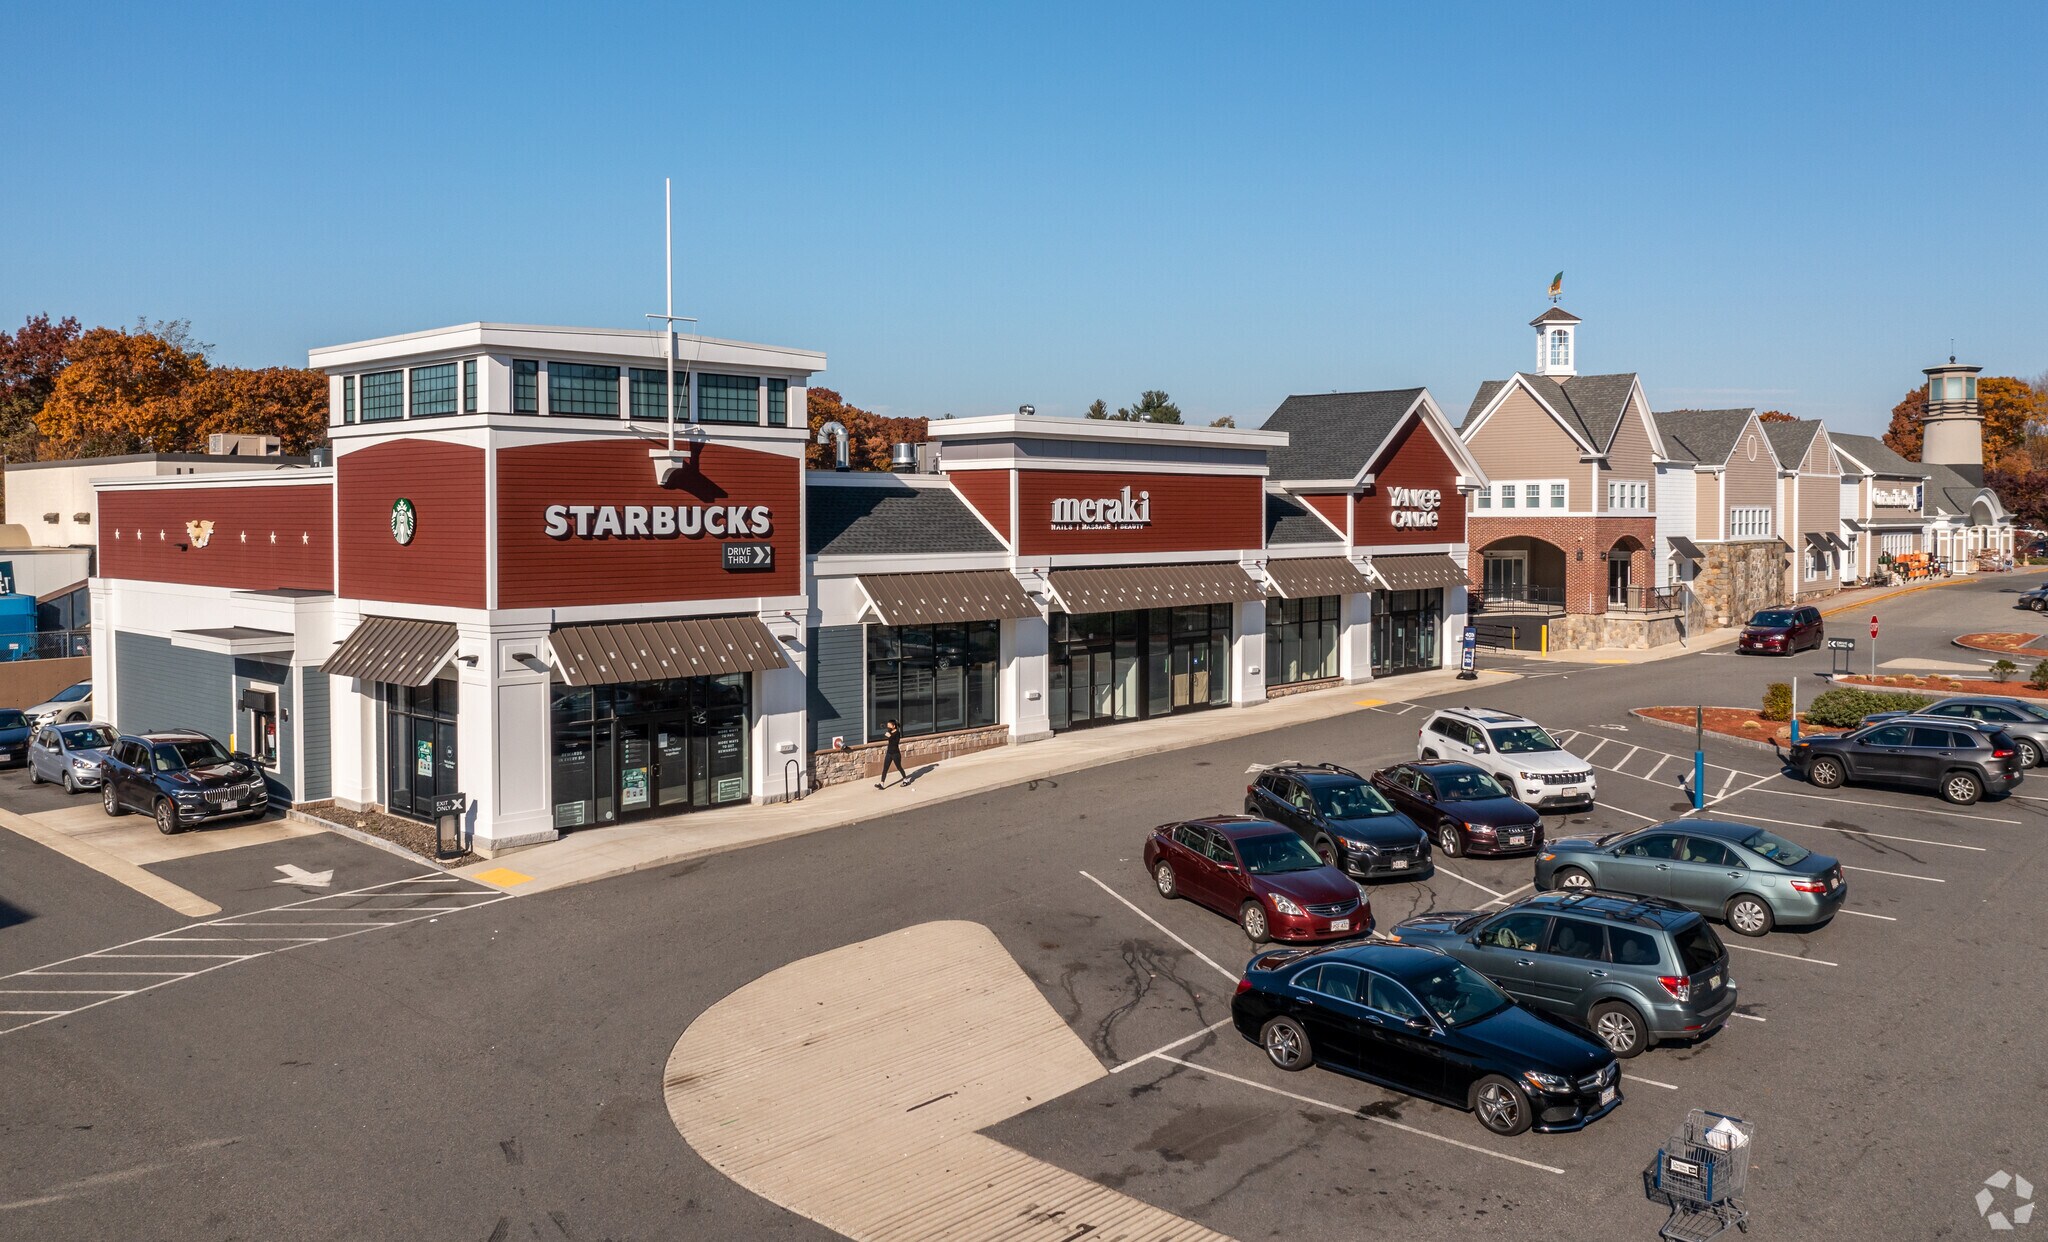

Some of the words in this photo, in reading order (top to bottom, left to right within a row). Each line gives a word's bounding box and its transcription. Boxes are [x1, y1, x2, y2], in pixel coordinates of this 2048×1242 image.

[1050, 485, 1151, 523] meraki
[544, 504, 771, 537] STARBUCKS
[727, 547, 752, 556] DRIVE
[728, 556, 750, 564] THRU
